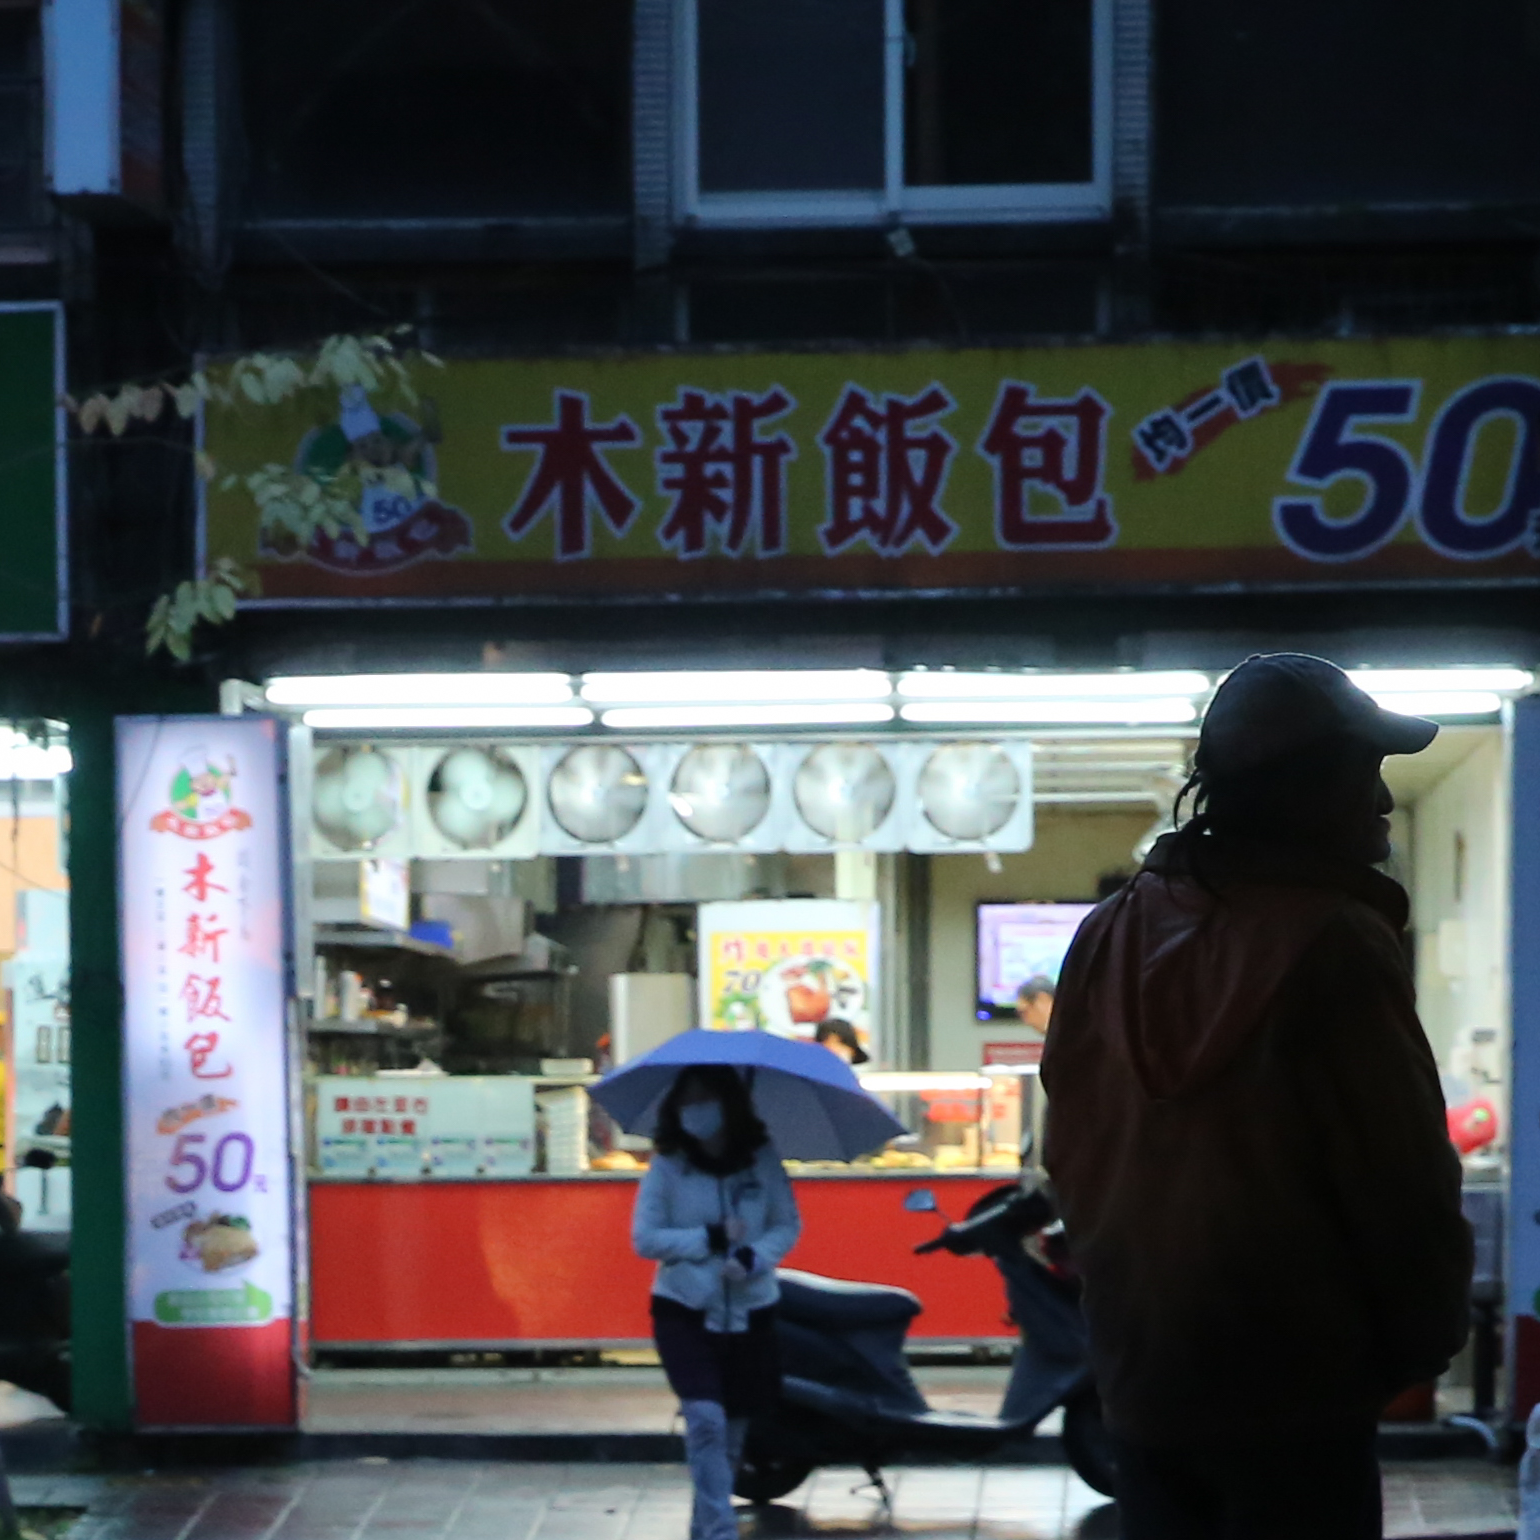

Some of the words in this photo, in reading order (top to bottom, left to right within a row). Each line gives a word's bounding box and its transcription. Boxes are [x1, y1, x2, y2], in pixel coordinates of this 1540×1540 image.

[502, 381, 1114, 557] 木新飯包
[177, 852, 234, 1079] 木新飯包
